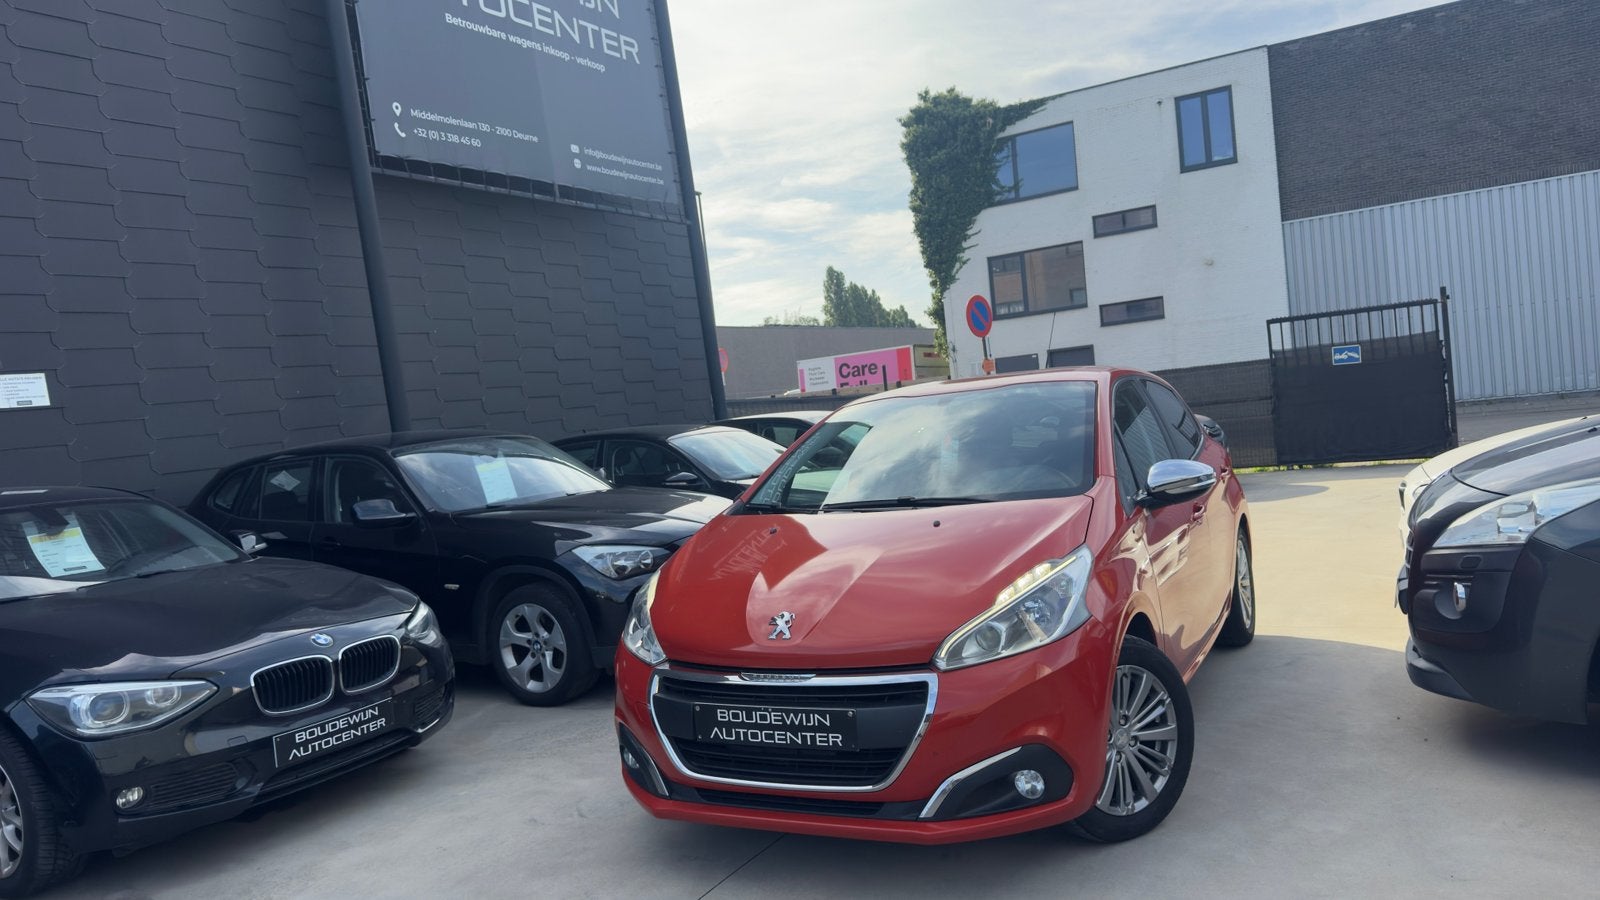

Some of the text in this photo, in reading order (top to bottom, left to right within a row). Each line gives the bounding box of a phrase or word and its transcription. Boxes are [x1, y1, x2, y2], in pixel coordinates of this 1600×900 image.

[445, 13, 507, 40] Betrouwbare
[508, 32, 542, 50] wagens
[542, 43, 570, 61] inkoop
[575, 55, 606, 72] verkoop
[410, 108, 478, 130] Middelmolenlaan
[478, 122, 491, 132] 130
[495, 126, 512, 137] 2100
[512, 130, 539, 143] Deurne
[413, 128, 481, 147] +32 (0) 3 318 45 60
[839, 363, 878, 379] Care
[295, 706, 379, 743] BOUDEWIJN
[717, 708, 830, 727] BOUDEWIJN
[289, 718, 386, 760] AUTOCENTER
[710, 727, 843, 747] AUTOCENTER
